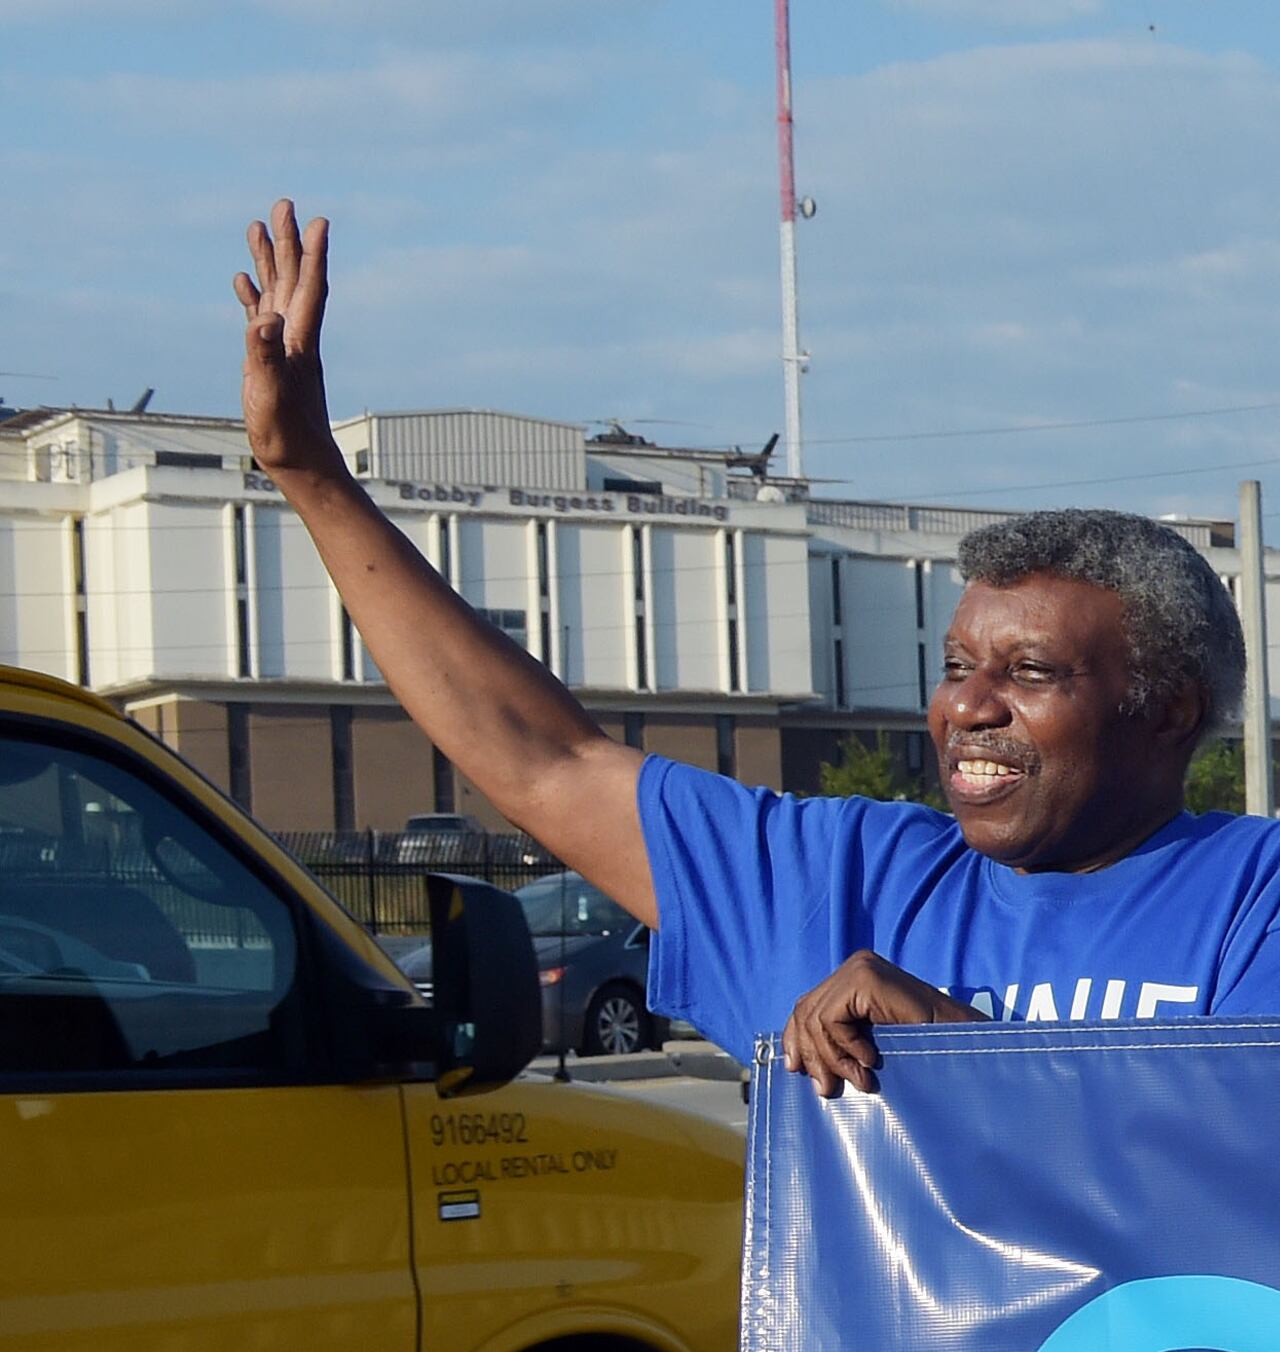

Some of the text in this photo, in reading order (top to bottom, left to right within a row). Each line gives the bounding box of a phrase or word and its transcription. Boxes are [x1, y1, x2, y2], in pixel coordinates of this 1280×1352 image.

[509, 489, 615, 512] Burgess
[626, 495, 729, 521] Building
[430, 1112, 529, 1146] 9166492
[432, 1148, 619, 1186] LOCAL RENTAL ONLY
